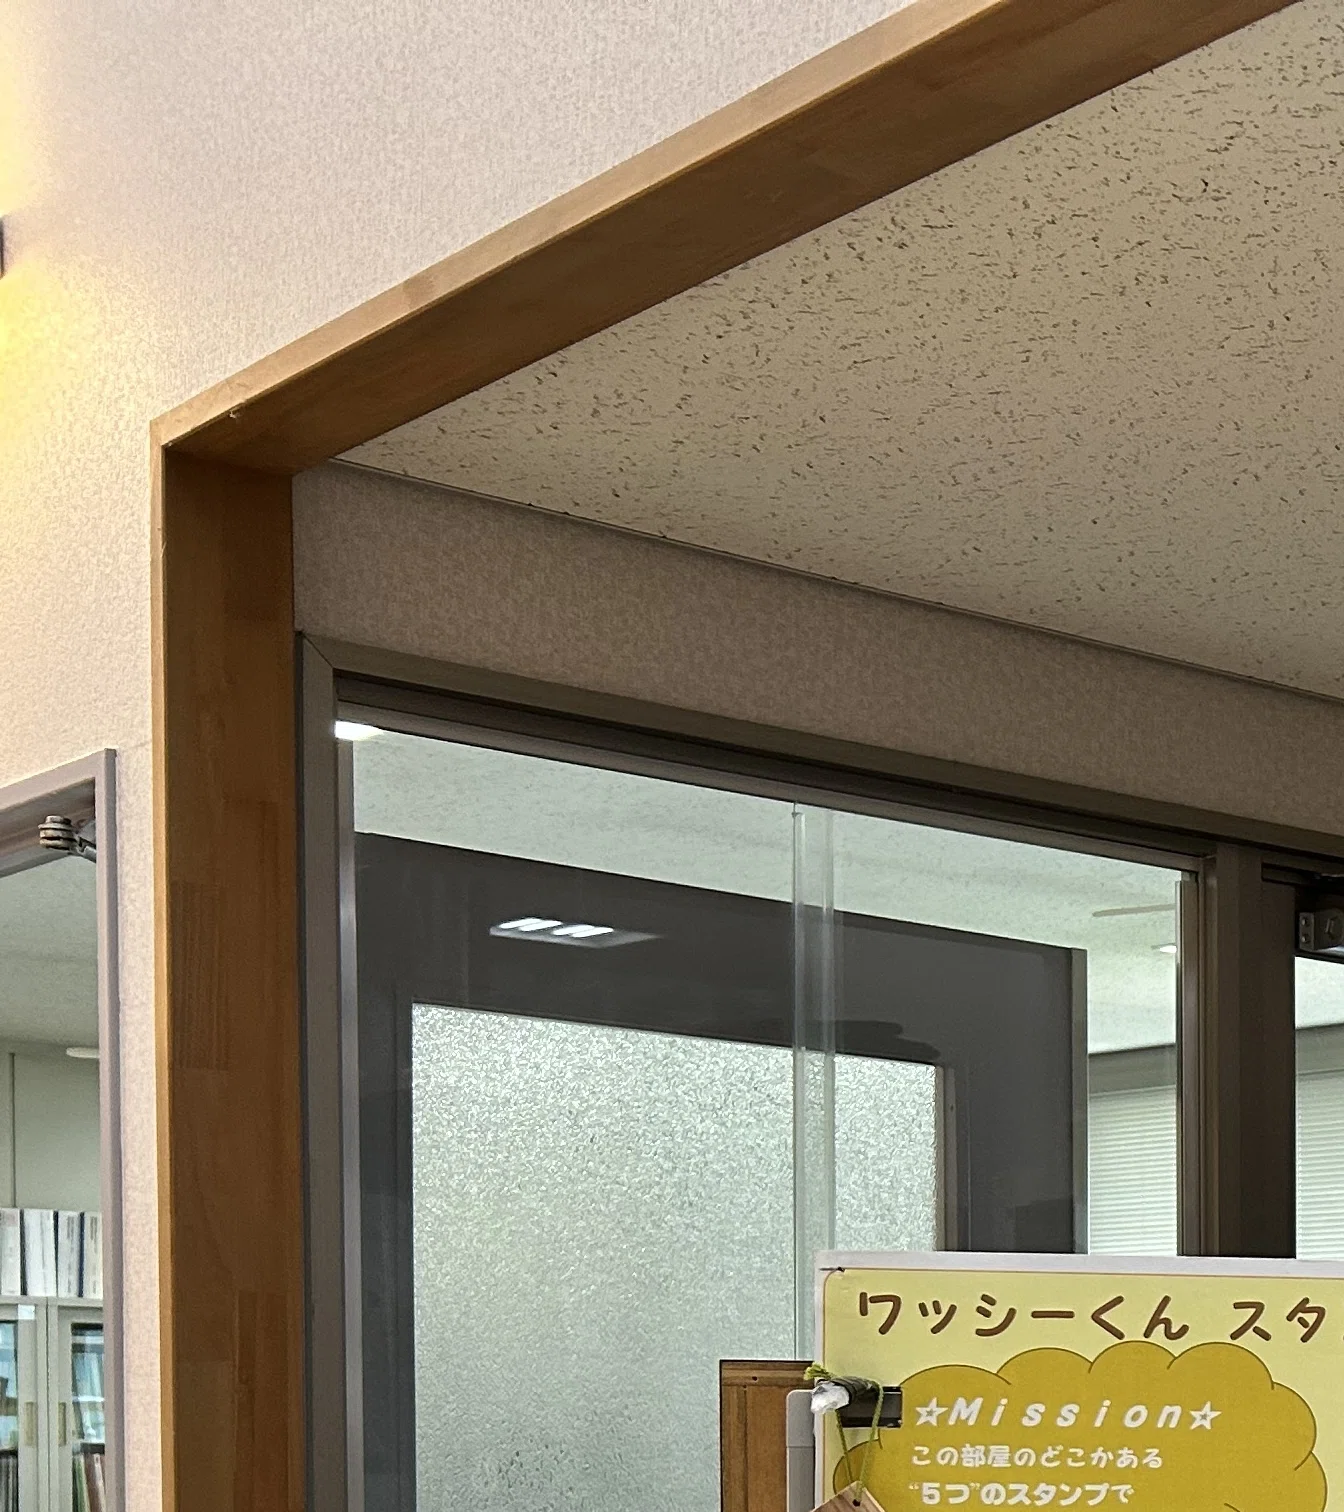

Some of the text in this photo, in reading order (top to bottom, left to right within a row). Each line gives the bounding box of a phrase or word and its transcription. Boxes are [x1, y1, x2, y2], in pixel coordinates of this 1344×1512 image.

[858, 1293, 1190, 1340] ワッシーくん
[911, 1444, 1165, 1469] この部屋のどこかある
